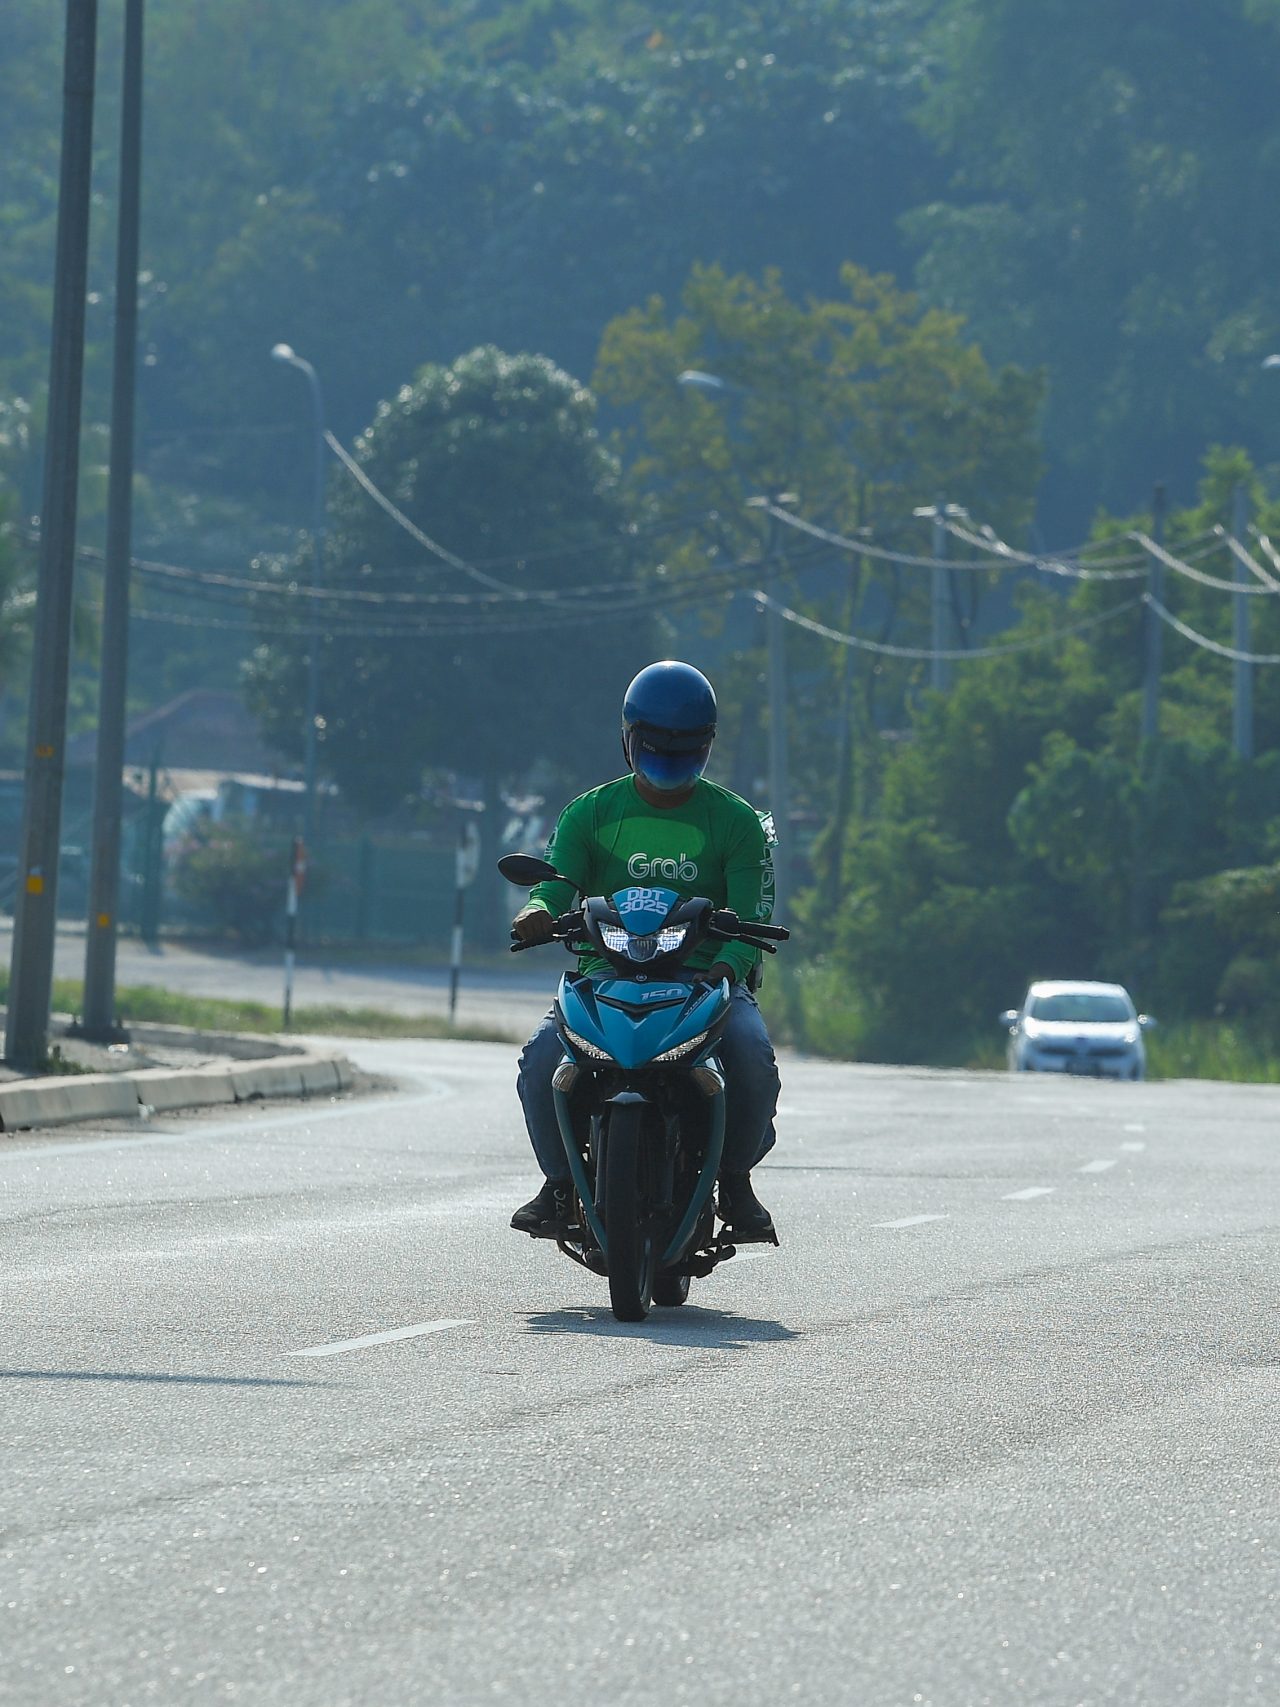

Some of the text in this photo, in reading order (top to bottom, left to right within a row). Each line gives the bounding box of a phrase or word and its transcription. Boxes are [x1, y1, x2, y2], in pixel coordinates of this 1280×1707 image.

[627, 852, 699, 882] Grab
[627, 887, 665, 902] DDT
[619, 900, 669, 916] 3025
[641, 988, 683, 1001] 150
